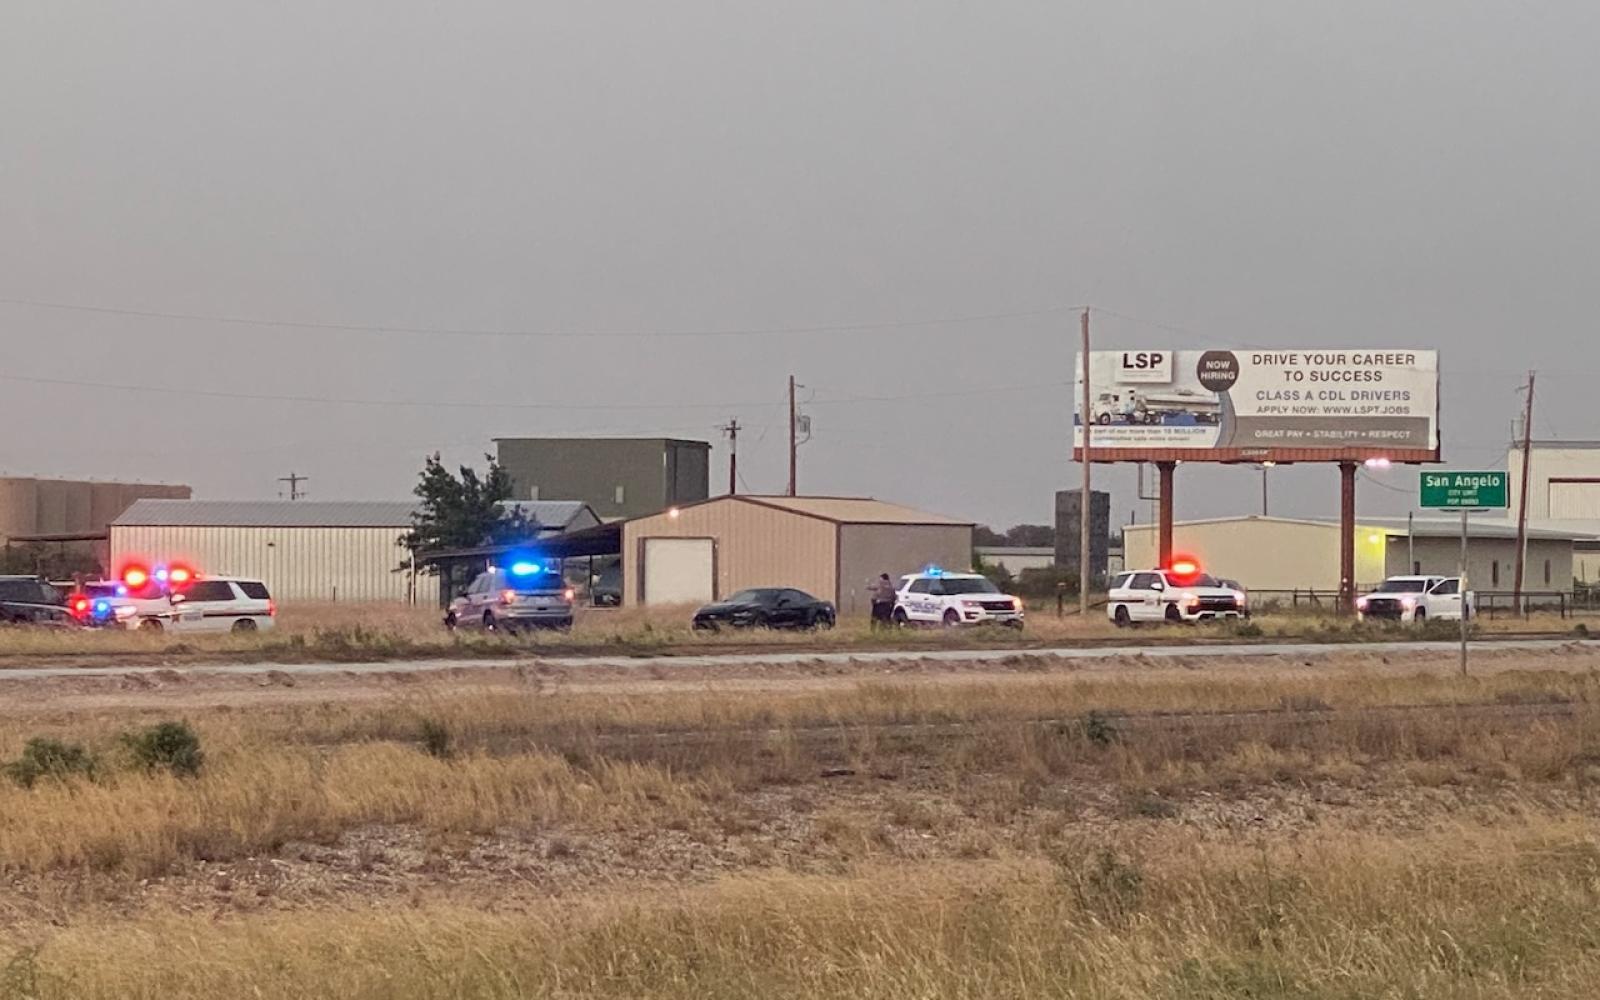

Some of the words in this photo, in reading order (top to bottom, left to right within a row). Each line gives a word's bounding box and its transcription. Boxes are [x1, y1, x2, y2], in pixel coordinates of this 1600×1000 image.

[1123, 353, 1163, 369] LSP
[1205, 360, 1231, 369] NOW
[1252, 354, 1298, 365] DRIVE
[1304, 354, 1347, 365] YOUR
[1352, 354, 1416, 365] CAREER
[1200, 371, 1236, 381] HIRING
[1284, 370, 1304, 382] TO
[1309, 370, 1383, 382] SUCCESS
[1256, 390, 1300, 401] CLASS
[1304, 390, 1314, 401] A
[1318, 390, 1346, 401] CDL
[1350, 390, 1411, 401] DRIVERS
[1256, 406, 1289, 414] APPLY
[1323, 406, 1411, 414] WWW.LSPT.JOBS
[1254, 429, 1284, 439] GREAT
[1286, 429, 1304, 439] PAY
[1313, 429, 1359, 439] STABILITY
[1368, 429, 1411, 439] RESPECT
[1426, 475, 1449, 487] San
[1454, 475, 1500, 489] Angelo
